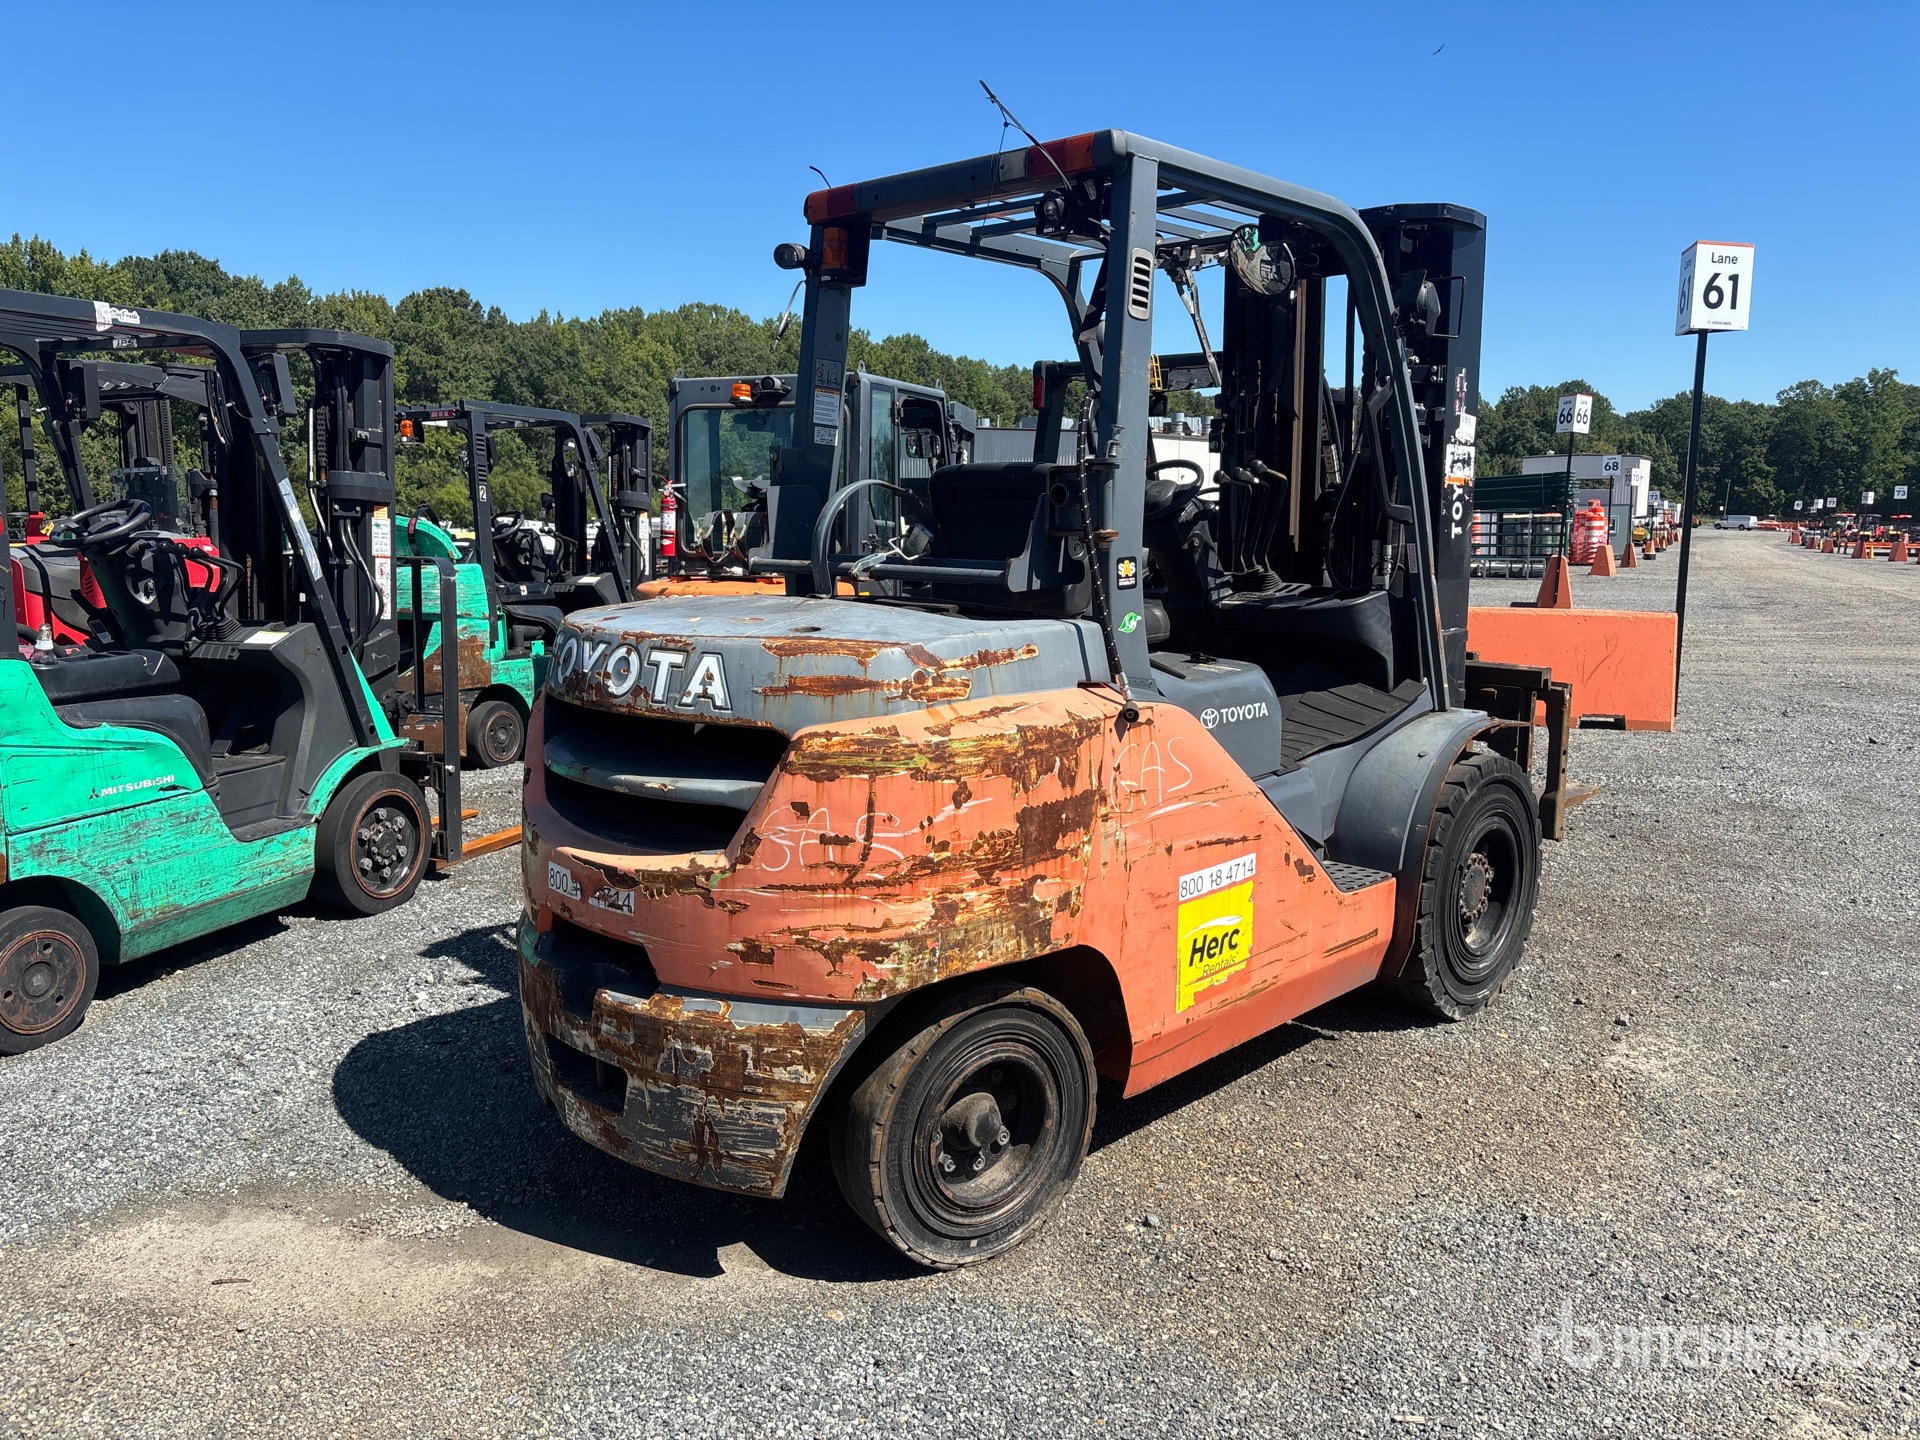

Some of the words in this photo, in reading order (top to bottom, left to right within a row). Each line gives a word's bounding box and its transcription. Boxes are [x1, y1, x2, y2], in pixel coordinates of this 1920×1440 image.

[1711, 252, 1738, 264] Lane
[1680, 275, 1692, 315] 61
[1703, 272, 1739, 310] 61
[1559, 408, 1573, 424] 66
[1576, 408, 1588, 425] 66
[1604, 461, 1619, 471] 68
[1633, 474, 1640, 482] 70
[480, 487, 486, 500] 2
[1118, 560, 1136, 577] SAS
[551, 632, 732, 713] TOYOTA
[1220, 702, 1269, 724] TOYOTA
[101, 774, 175, 796] MITSUBISHI
[1110, 736, 1193, 813] GAS
[549, 868, 569, 893] 800
[1180, 875, 1204, 898] 800
[1226, 858, 1254, 881] 4714
[1188, 928, 1240, 967] Herc
[1202, 955, 1237, 977] Rentals
